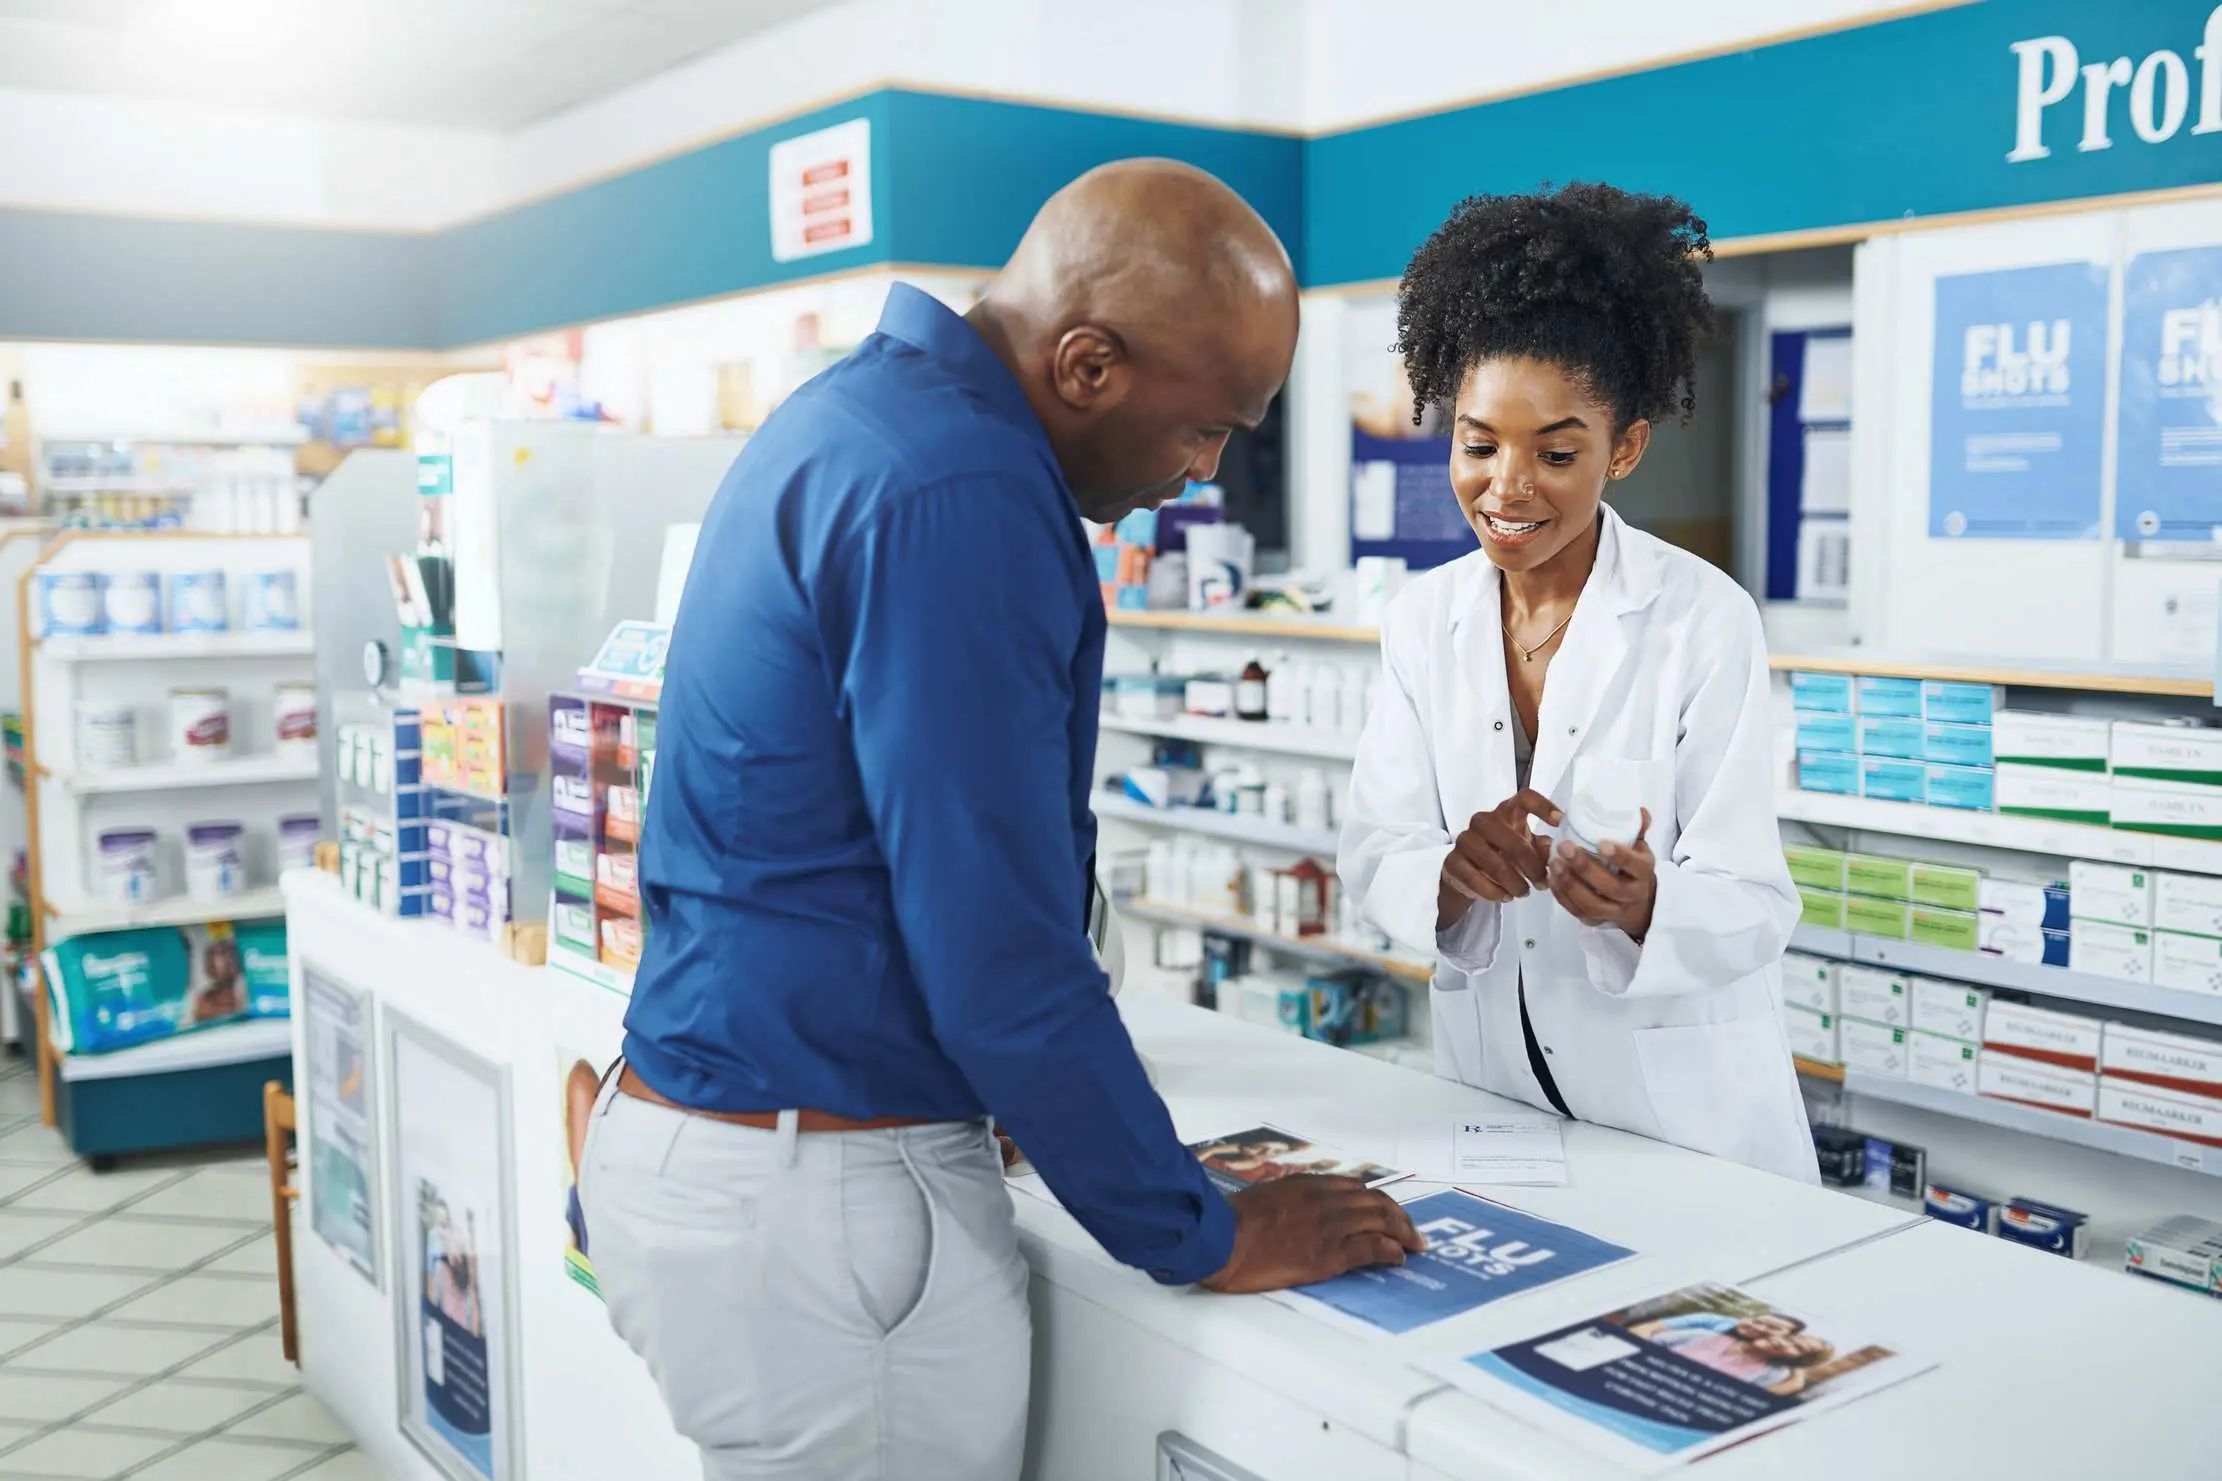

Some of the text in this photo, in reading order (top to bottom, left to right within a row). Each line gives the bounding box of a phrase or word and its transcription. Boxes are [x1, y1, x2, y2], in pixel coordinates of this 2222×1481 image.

[1963, 319, 2071, 367] FLU
[1962, 362, 2070, 396] SHOTS
[1416, 1216, 1557, 1266] FLU
